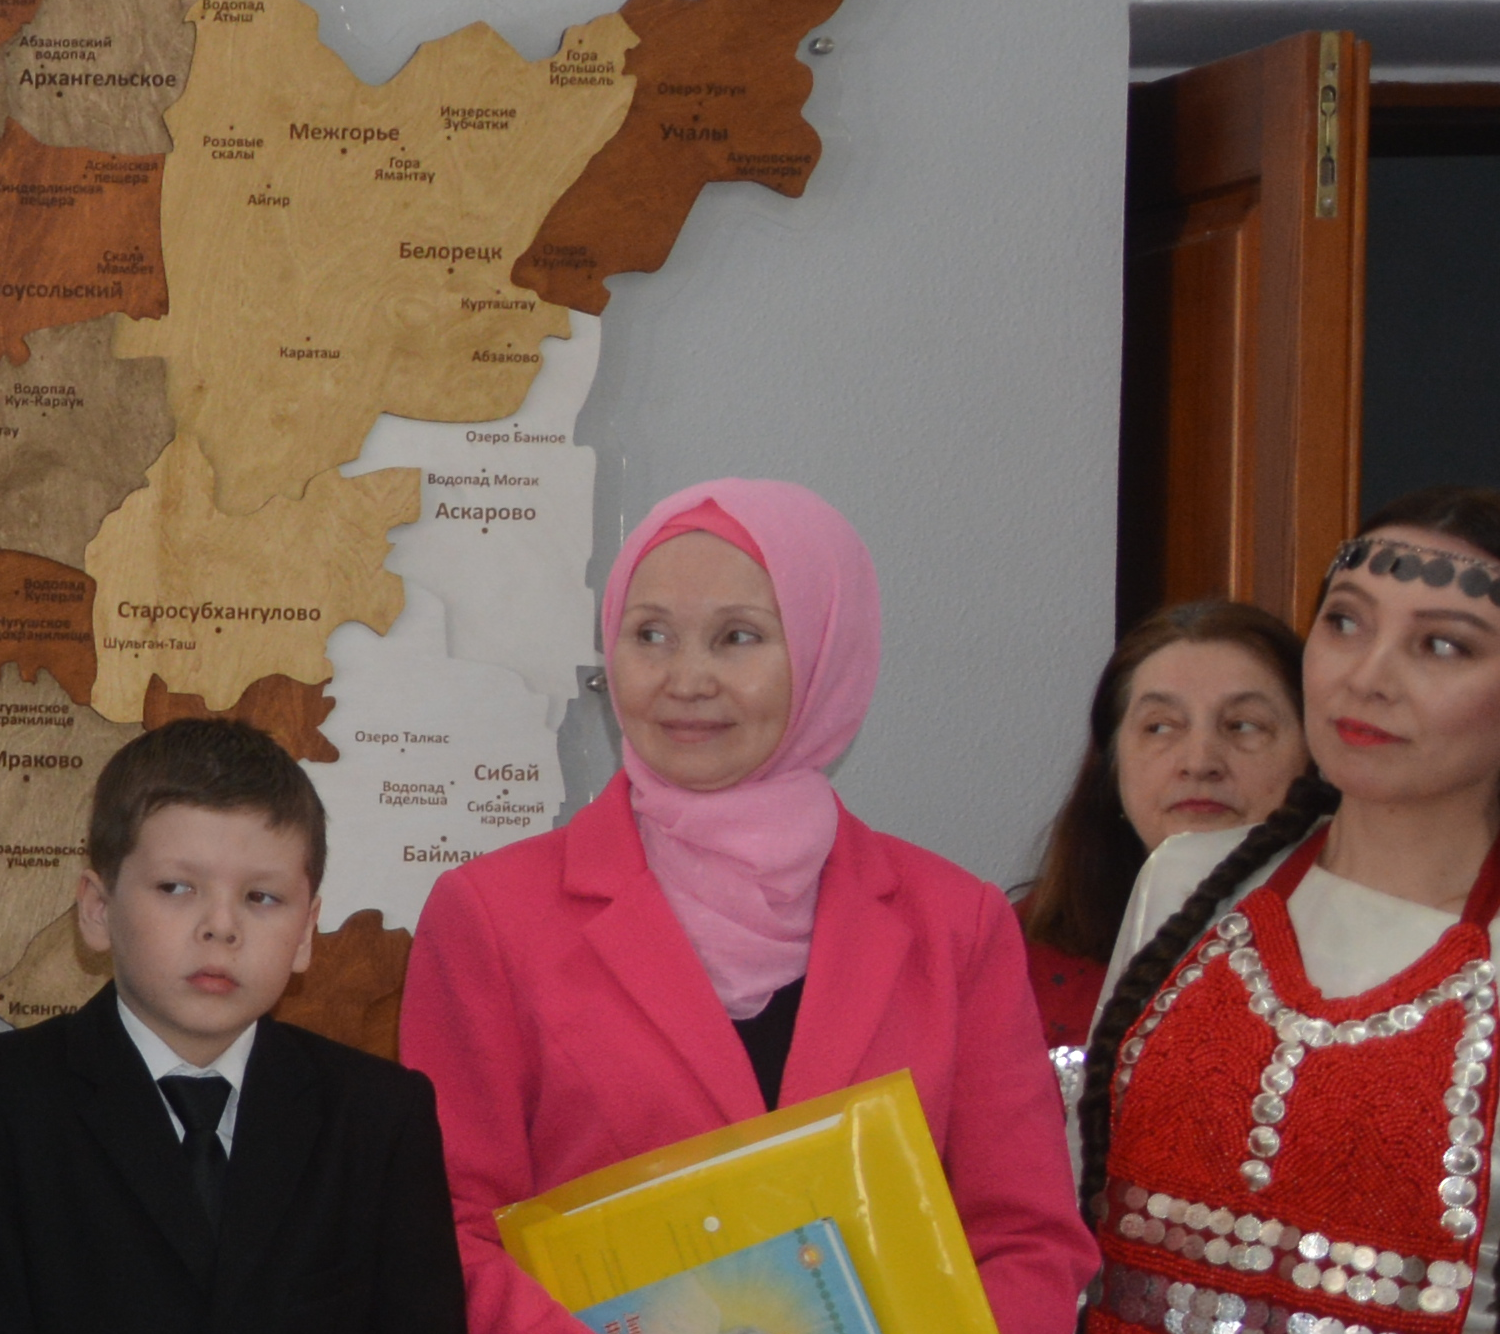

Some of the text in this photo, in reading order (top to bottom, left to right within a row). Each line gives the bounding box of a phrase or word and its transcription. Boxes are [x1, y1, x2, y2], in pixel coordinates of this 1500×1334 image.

[213, 11, 253, 22] Атыш
[20, 35, 112, 49] Абзановский
[35, 49, 97, 62] водопад
[567, 50, 598, 63] Гора
[20, 70, 176, 89] Архангельское
[550, 74, 614, 87] Иремель
[657, 84, 701, 96] Озеро
[441, 106, 516, 119] Инзерские
[443, 119, 509, 131] Зубчатки
[289, 123, 399, 144] Межгорье
[660, 125, 728, 143] Учалы
[203, 136, 264, 150] Розовые
[212, 149, 255, 160] скалы
[389, 158, 420, 170] Гора
[375, 170, 436, 184] Ямантау
[247, 195, 290, 208] Айгир
[400, 242, 503, 264] Белорецк
[280, 346, 341, 359] Караташ
[472, 350, 540, 364] Абзаково
[14, 384, 75, 397] Водопад
[466, 431, 566, 444] Озеро Банное
[428, 474, 489, 487] Водопад
[435, 503, 536, 522] Аскарово
[117, 600, 322, 623] Старосубхангулово
[103, 638, 196, 650] Шульган-Таш
[355, 731, 450, 745] Озеро Талкас
[474, 765, 540, 782] Сибай
[382, 781, 445, 795] Водопад
[379, 793, 448, 806] Гадельша
[467, 801, 544, 813] Сибайский
[480, 815, 531, 827] карьер
[7, 857, 60, 868] ущелье
